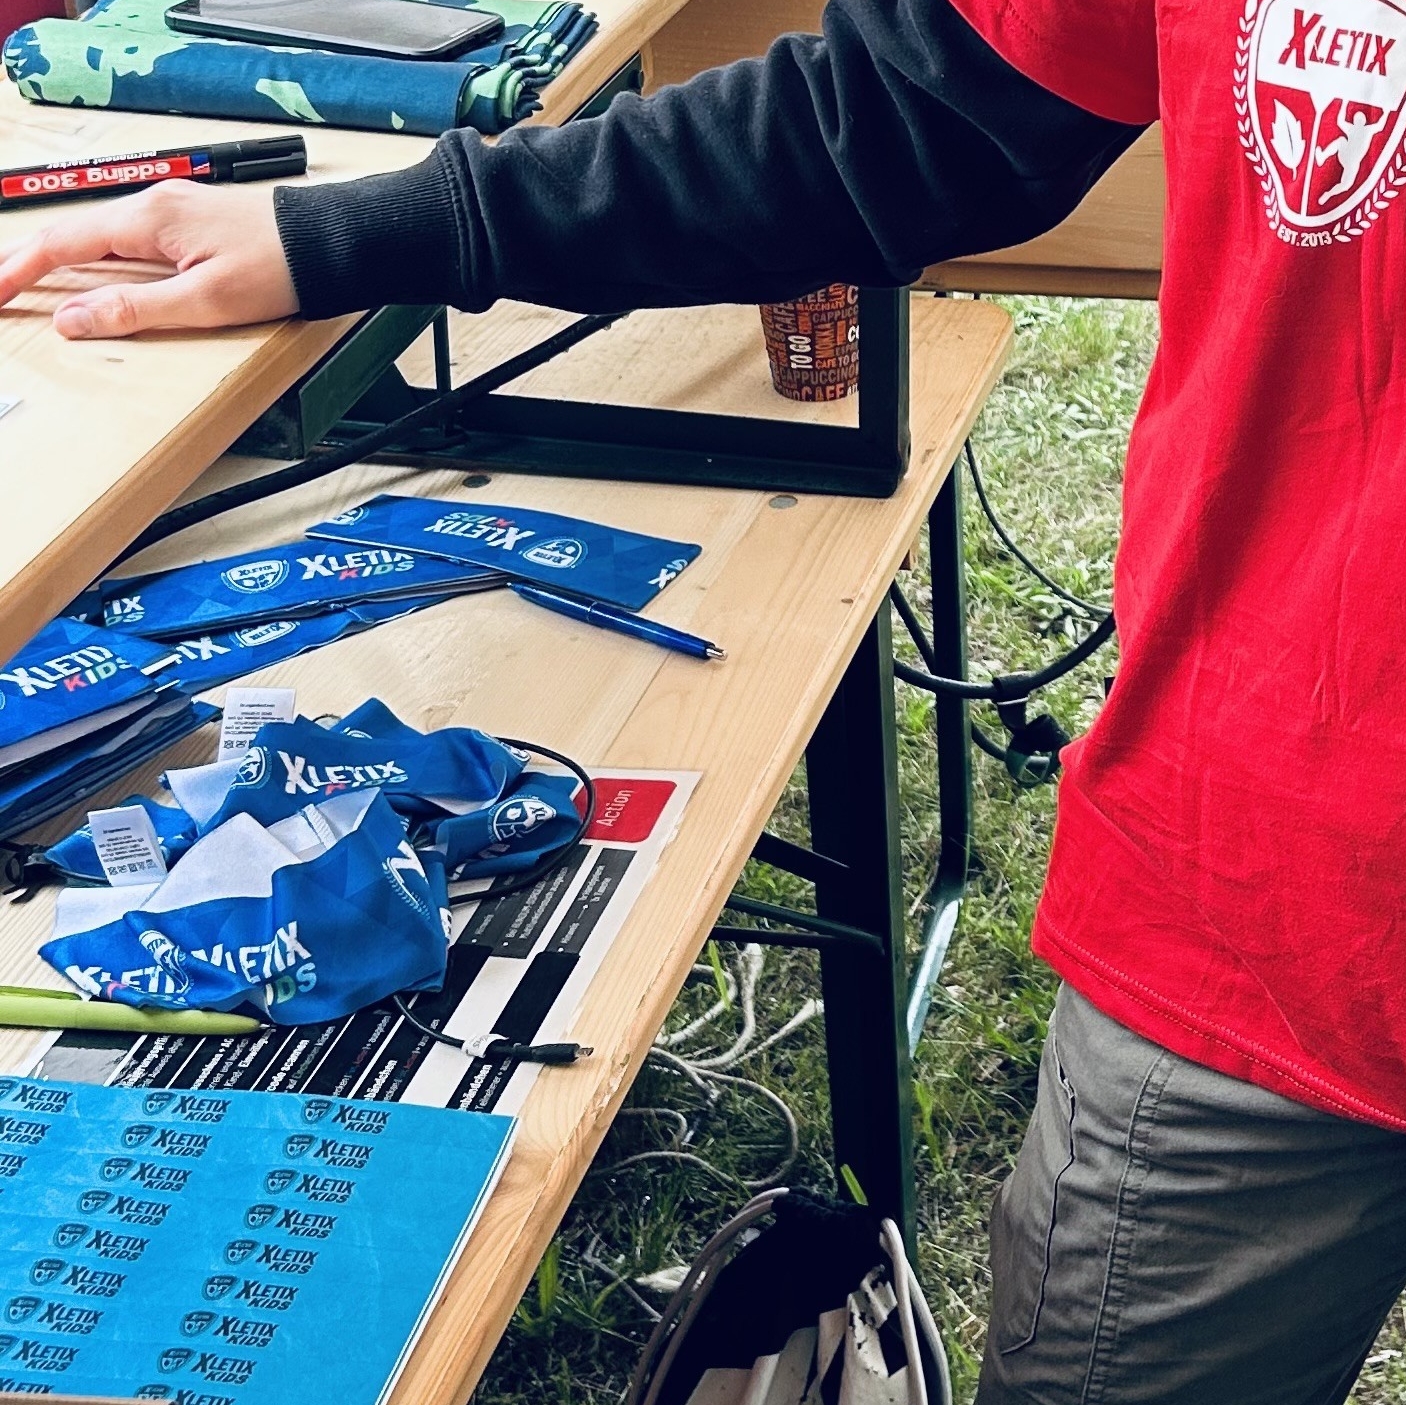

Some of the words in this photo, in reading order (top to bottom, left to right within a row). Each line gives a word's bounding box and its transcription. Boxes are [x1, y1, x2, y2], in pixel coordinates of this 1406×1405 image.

[1278, 8, 1397, 77] XLETIX
[22, 171, 79, 193] 300
[86, 160, 172, 184] edding
[787, 335, 812, 353] GO
[789, 354, 814, 369] TO
[444, 512, 517, 529] KIDS
[423, 518, 538, 551] XLETIX
[339, 560, 416, 582] KIDS
[277, 749, 407, 795] XLETIX
[596, 789, 635, 828] Action
[11, 1084, 74, 1104] XLETIX
[23, 1100, 65, 1113] KIDS
[171, 1095, 232, 1114] XLETIX
[331, 1104, 391, 1125] XLETIX
[183, 1112, 225, 1123] KIDS
[151, 1128, 212, 1148] XLETIX
[343, 1122, 385, 1135] KIDS
[163, 1145, 206, 1158] KIDS
[313, 1139, 374, 1159] XLETIX
[130, 1162, 193, 1183] XLETIX
[326, 1156, 367, 1169] KIDS
[142, 1180, 186, 1192] KIDS
[295, 1174, 356, 1195] XLETIX
[107, 1195, 172, 1217] XLETIX
[307, 1191, 350, 1204] KIDS
[120, 1213, 164, 1226] KIDS
[274, 1209, 338, 1230] XLETIX
[85, 1229, 151, 1252] XLETIX
[288, 1226, 331, 1239] KIDS
[98, 1248, 143, 1261] KIDS
[256, 1244, 319, 1265] XLETIX
[60, 1265, 128, 1288] XLETIX
[268, 1262, 312, 1275] KIDS
[74, 1284, 119, 1298] KIDS
[234, 1280, 299, 1301] XLETIX
[37, 1302, 105, 1325] XLETIX
[247, 1297, 292, 1311] KIDS
[50, 1321, 96, 1335] KIDS
[212, 1316, 279, 1337] XLETIX
[11, 1340, 80, 1362] XLETIX
[226, 1334, 271, 1348] KIDS
[24, 1358, 71, 1372] KIDS
[191, 1352, 257, 1374] XLETIX
[204, 1371, 249, 1384] KIDS
